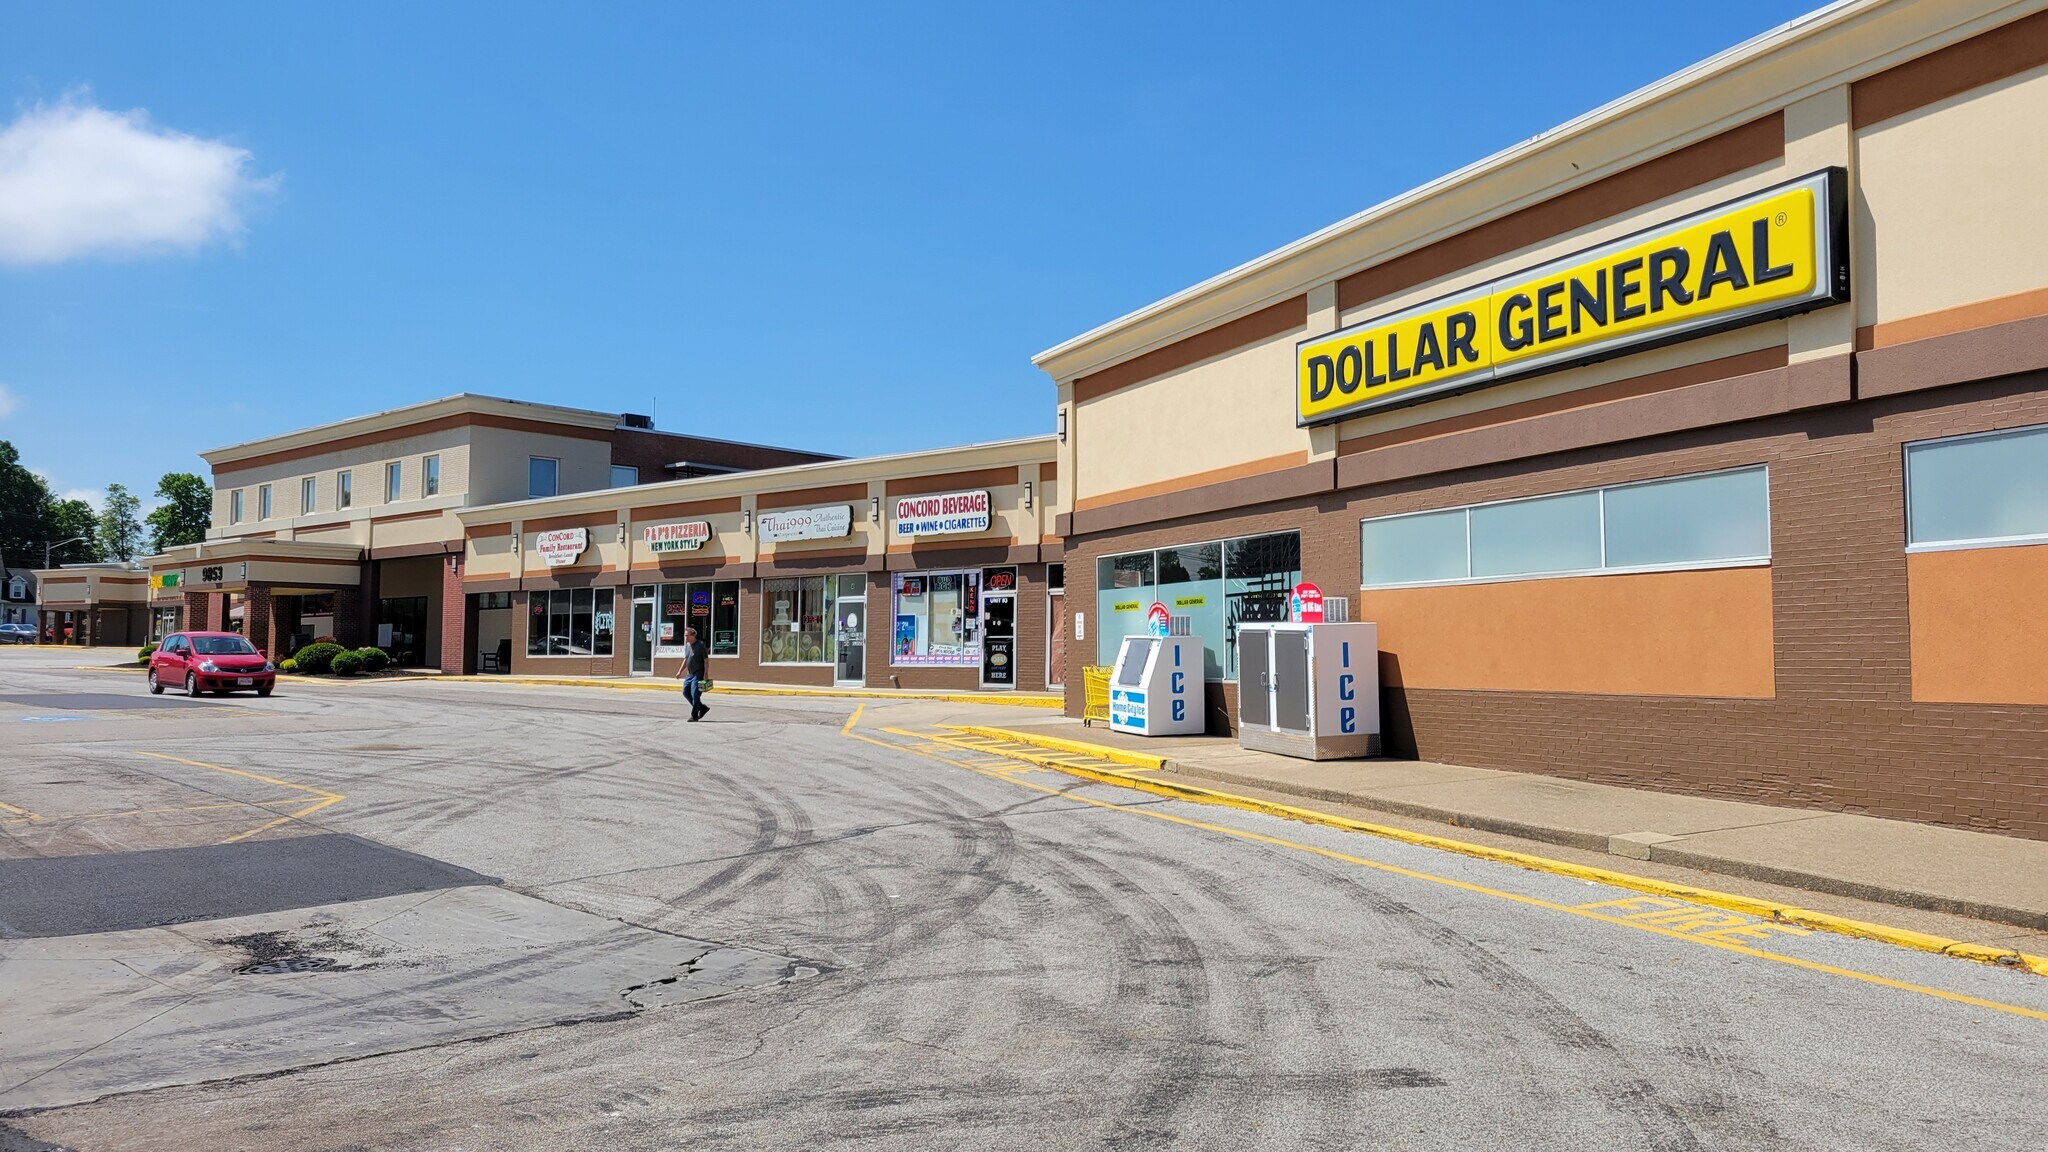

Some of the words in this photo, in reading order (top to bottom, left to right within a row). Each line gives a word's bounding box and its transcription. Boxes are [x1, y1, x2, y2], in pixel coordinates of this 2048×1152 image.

[1307, 321, 1479, 402] DOLLAR
[1498, 216, 1795, 352] GENERAL
[898, 500, 940, 519] CONCORD
[942, 495, 986, 515] BEVERAGE
[645, 528, 650, 541] P
[651, 528, 656, 541] &
[671, 523, 707, 539] PIZZERIA
[898, 523, 914, 534] BEER
[920, 521, 938, 532] WINE
[944, 516, 986, 530] CIGARETTES
[540, 544, 555, 553] Family
[557, 542, 583, 551] Restaurant
[651, 541, 662, 551] NEW
[664, 540, 679, 550] YORK
[680, 538, 698, 549] STYLE
[202, 566, 223, 582] 9853
[989, 574, 1012, 587] OPEN
[1113, 702, 1126, 712] Home
[1128, 704, 1136, 716] City
[1137, 705, 1145, 715] Ice
[1575, 896, 1812, 945] FIRE
